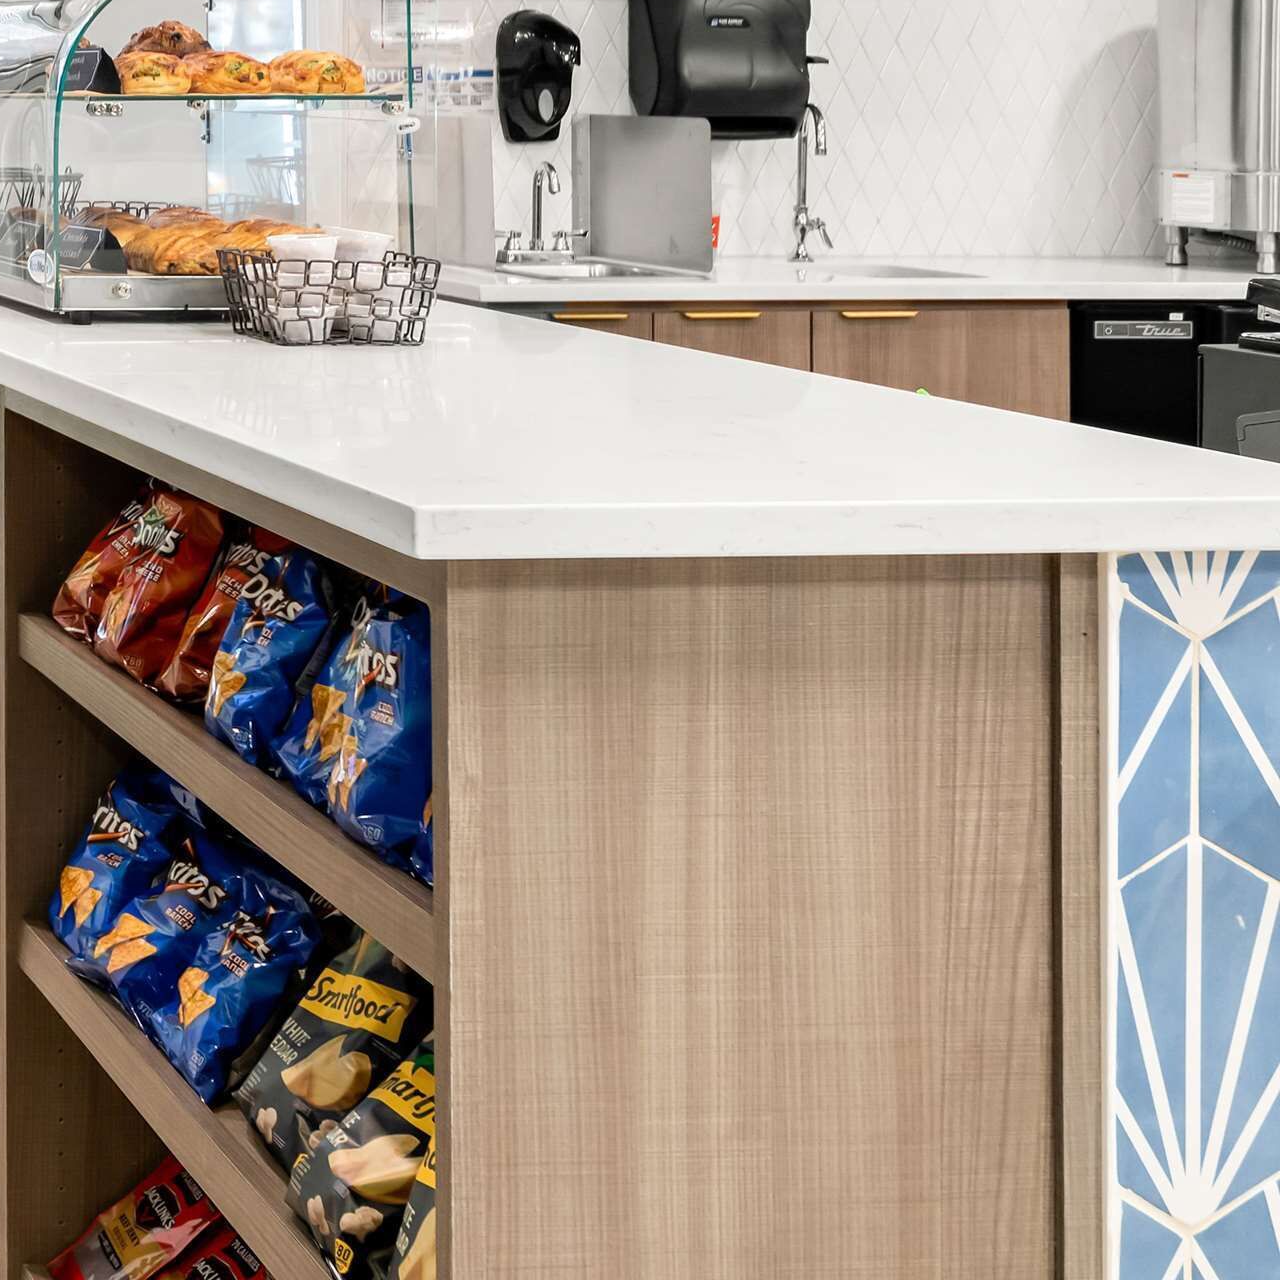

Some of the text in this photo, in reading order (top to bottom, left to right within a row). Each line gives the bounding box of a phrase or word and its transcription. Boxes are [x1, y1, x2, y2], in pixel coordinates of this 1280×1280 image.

[1135, 323, 1187, 338] true
[92, 805, 145, 852] ritos
[170, 860, 226, 910] ritos
[165, 906, 193, 932] RANCH
[175, 904, 197, 920] COOL
[270, 1031, 300, 1065] EDDAR
